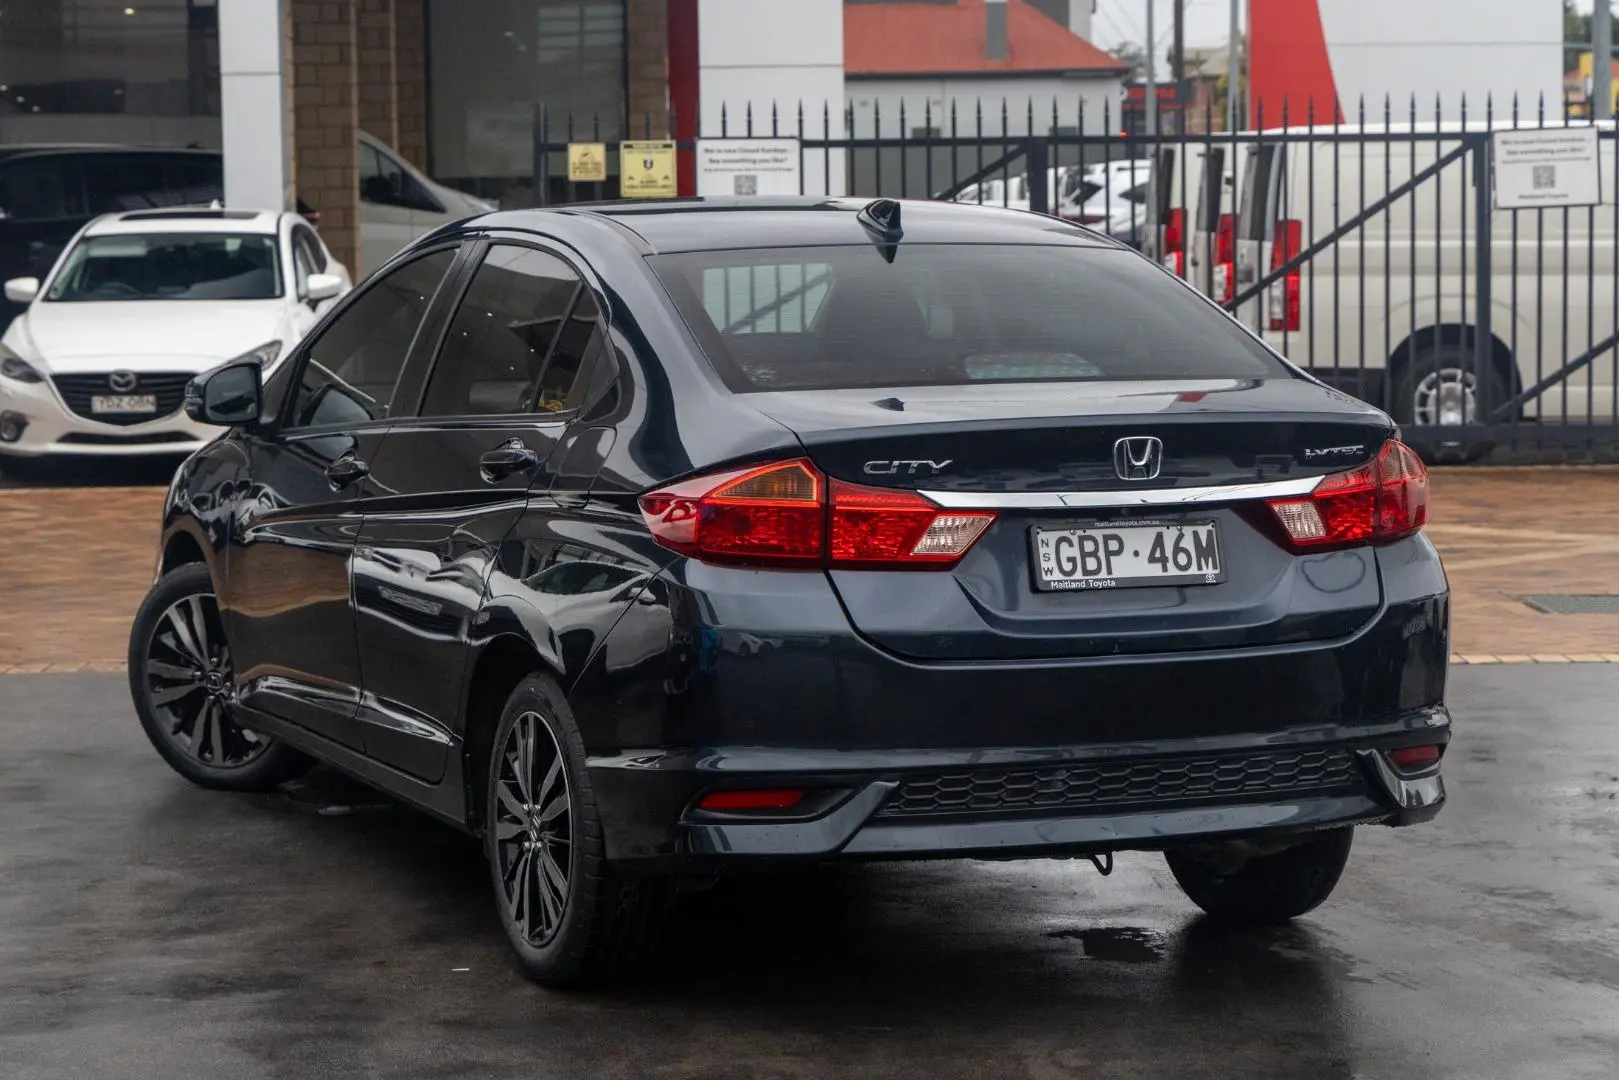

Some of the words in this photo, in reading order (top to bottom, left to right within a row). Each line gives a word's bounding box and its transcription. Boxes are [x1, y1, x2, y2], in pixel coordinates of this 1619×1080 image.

[863, 460, 953, 475] CITY
[1050, 579, 1086, 589] Maitland
[1088, 578, 1116, 588] Toyota
